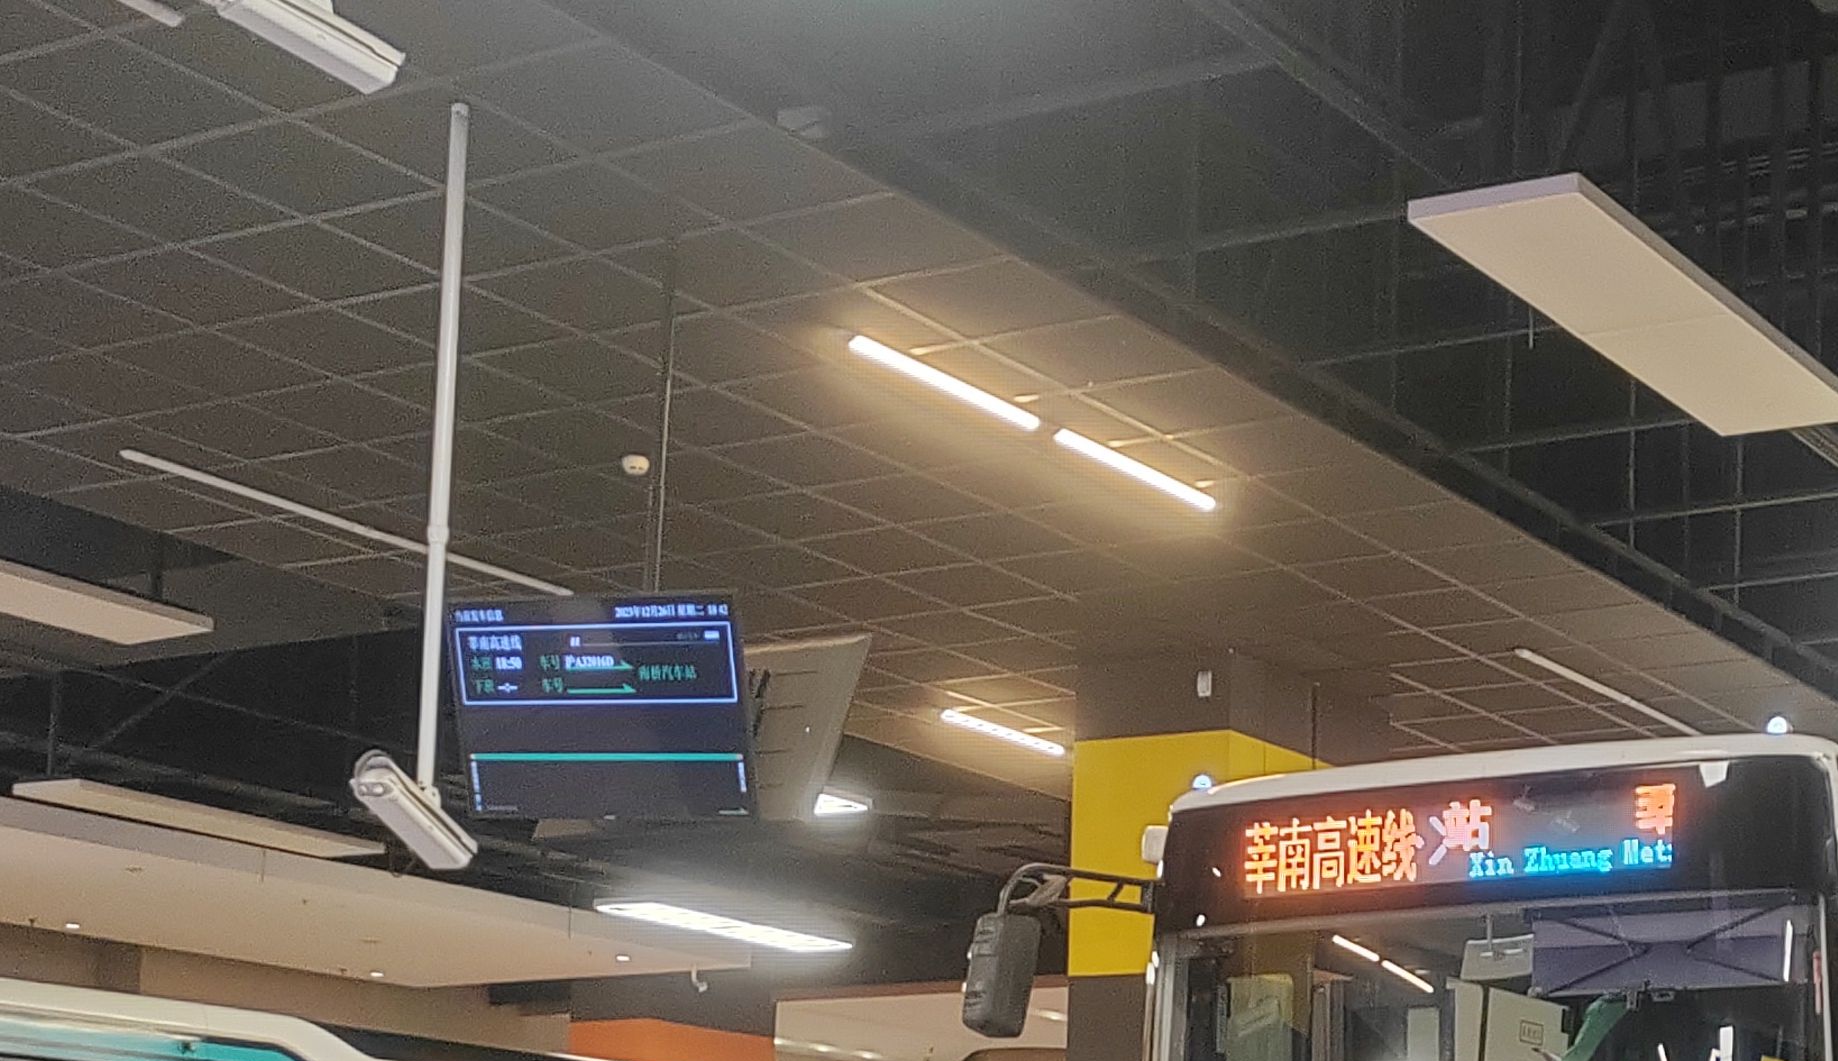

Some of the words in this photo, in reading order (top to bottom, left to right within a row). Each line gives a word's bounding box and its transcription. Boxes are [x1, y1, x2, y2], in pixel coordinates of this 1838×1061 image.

[1244, 808, 1425, 895] 莘南高速线
[1468, 850, 1515, 878] Xin
[1523, 845, 1615, 873] Zhuang
